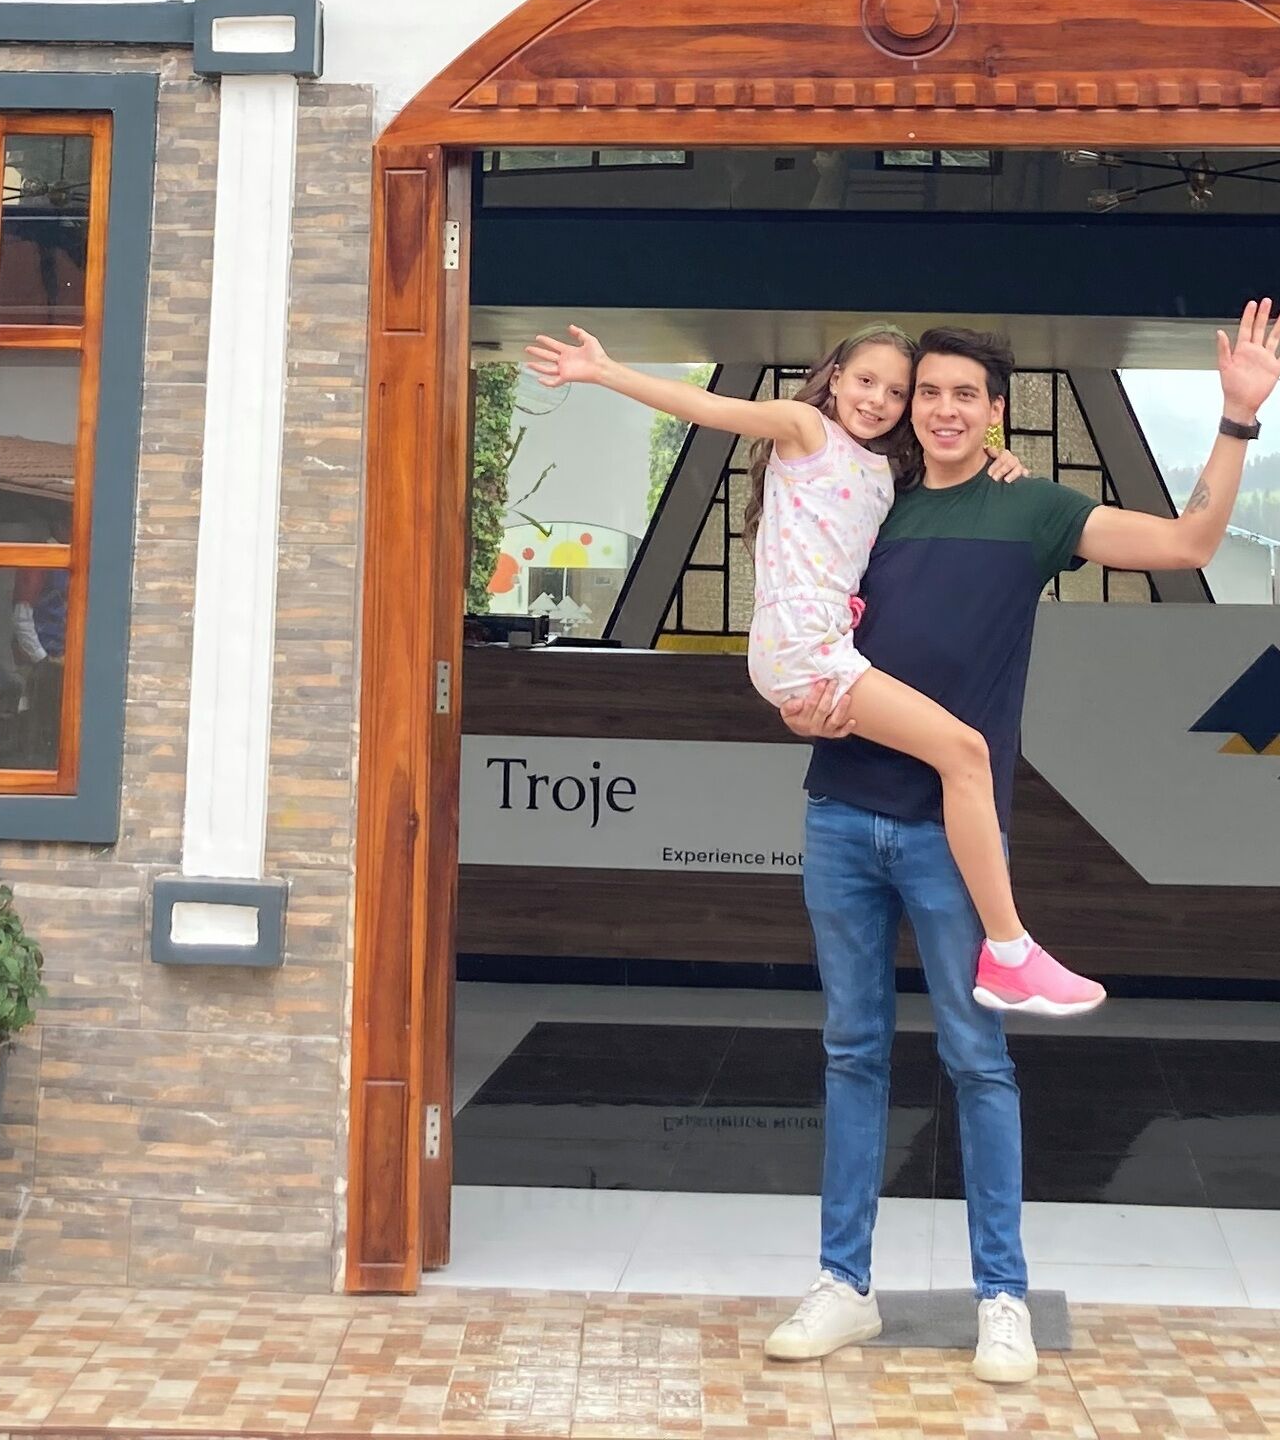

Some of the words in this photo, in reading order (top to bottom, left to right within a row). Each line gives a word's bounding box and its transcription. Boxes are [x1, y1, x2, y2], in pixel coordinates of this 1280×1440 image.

[486, 757, 637, 828] Troje
[662, 847, 766, 866] Experience
[771, 851, 805, 867] Hot
